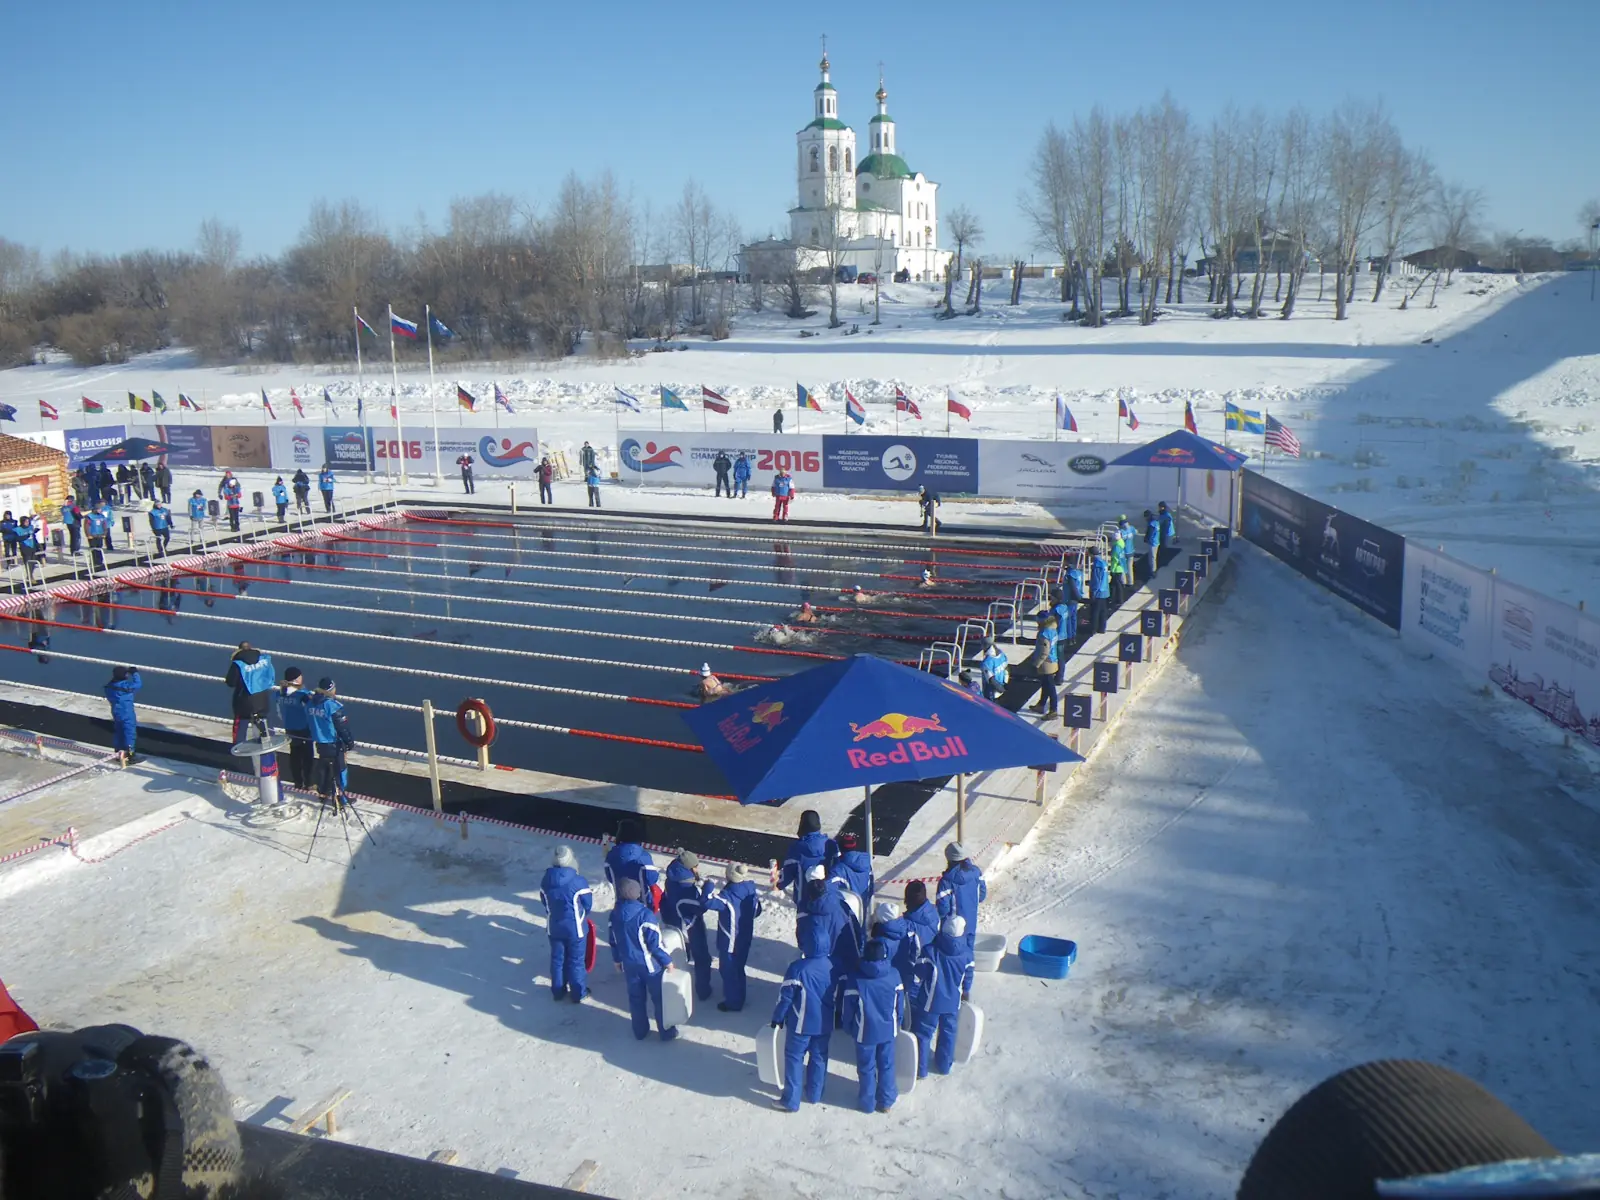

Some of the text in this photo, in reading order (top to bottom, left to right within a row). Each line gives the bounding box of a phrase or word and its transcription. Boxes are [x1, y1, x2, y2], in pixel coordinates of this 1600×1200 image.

[81, 437, 122, 448] ЮГОРИЯ
[335, 451, 366, 459] ТЮМЕНИ
[376, 440, 422, 459] 2016
[757, 450, 820, 472] 2016
[1216, 533, 1226, 541] 10
[1206, 547, 1213, 556] 9
[1194, 561, 1202, 571] 8
[1180, 577, 1189, 588] 7
[1164, 597, 1173, 608] 6
[1147, 618, 1156, 629] 5
[1125, 642, 1136, 654] 4
[244, 659, 269, 673] STAFF
[1100, 671, 1111, 684] 3
[1072, 704, 1083, 718] 2
[846, 736, 969, 769] Red Bull
